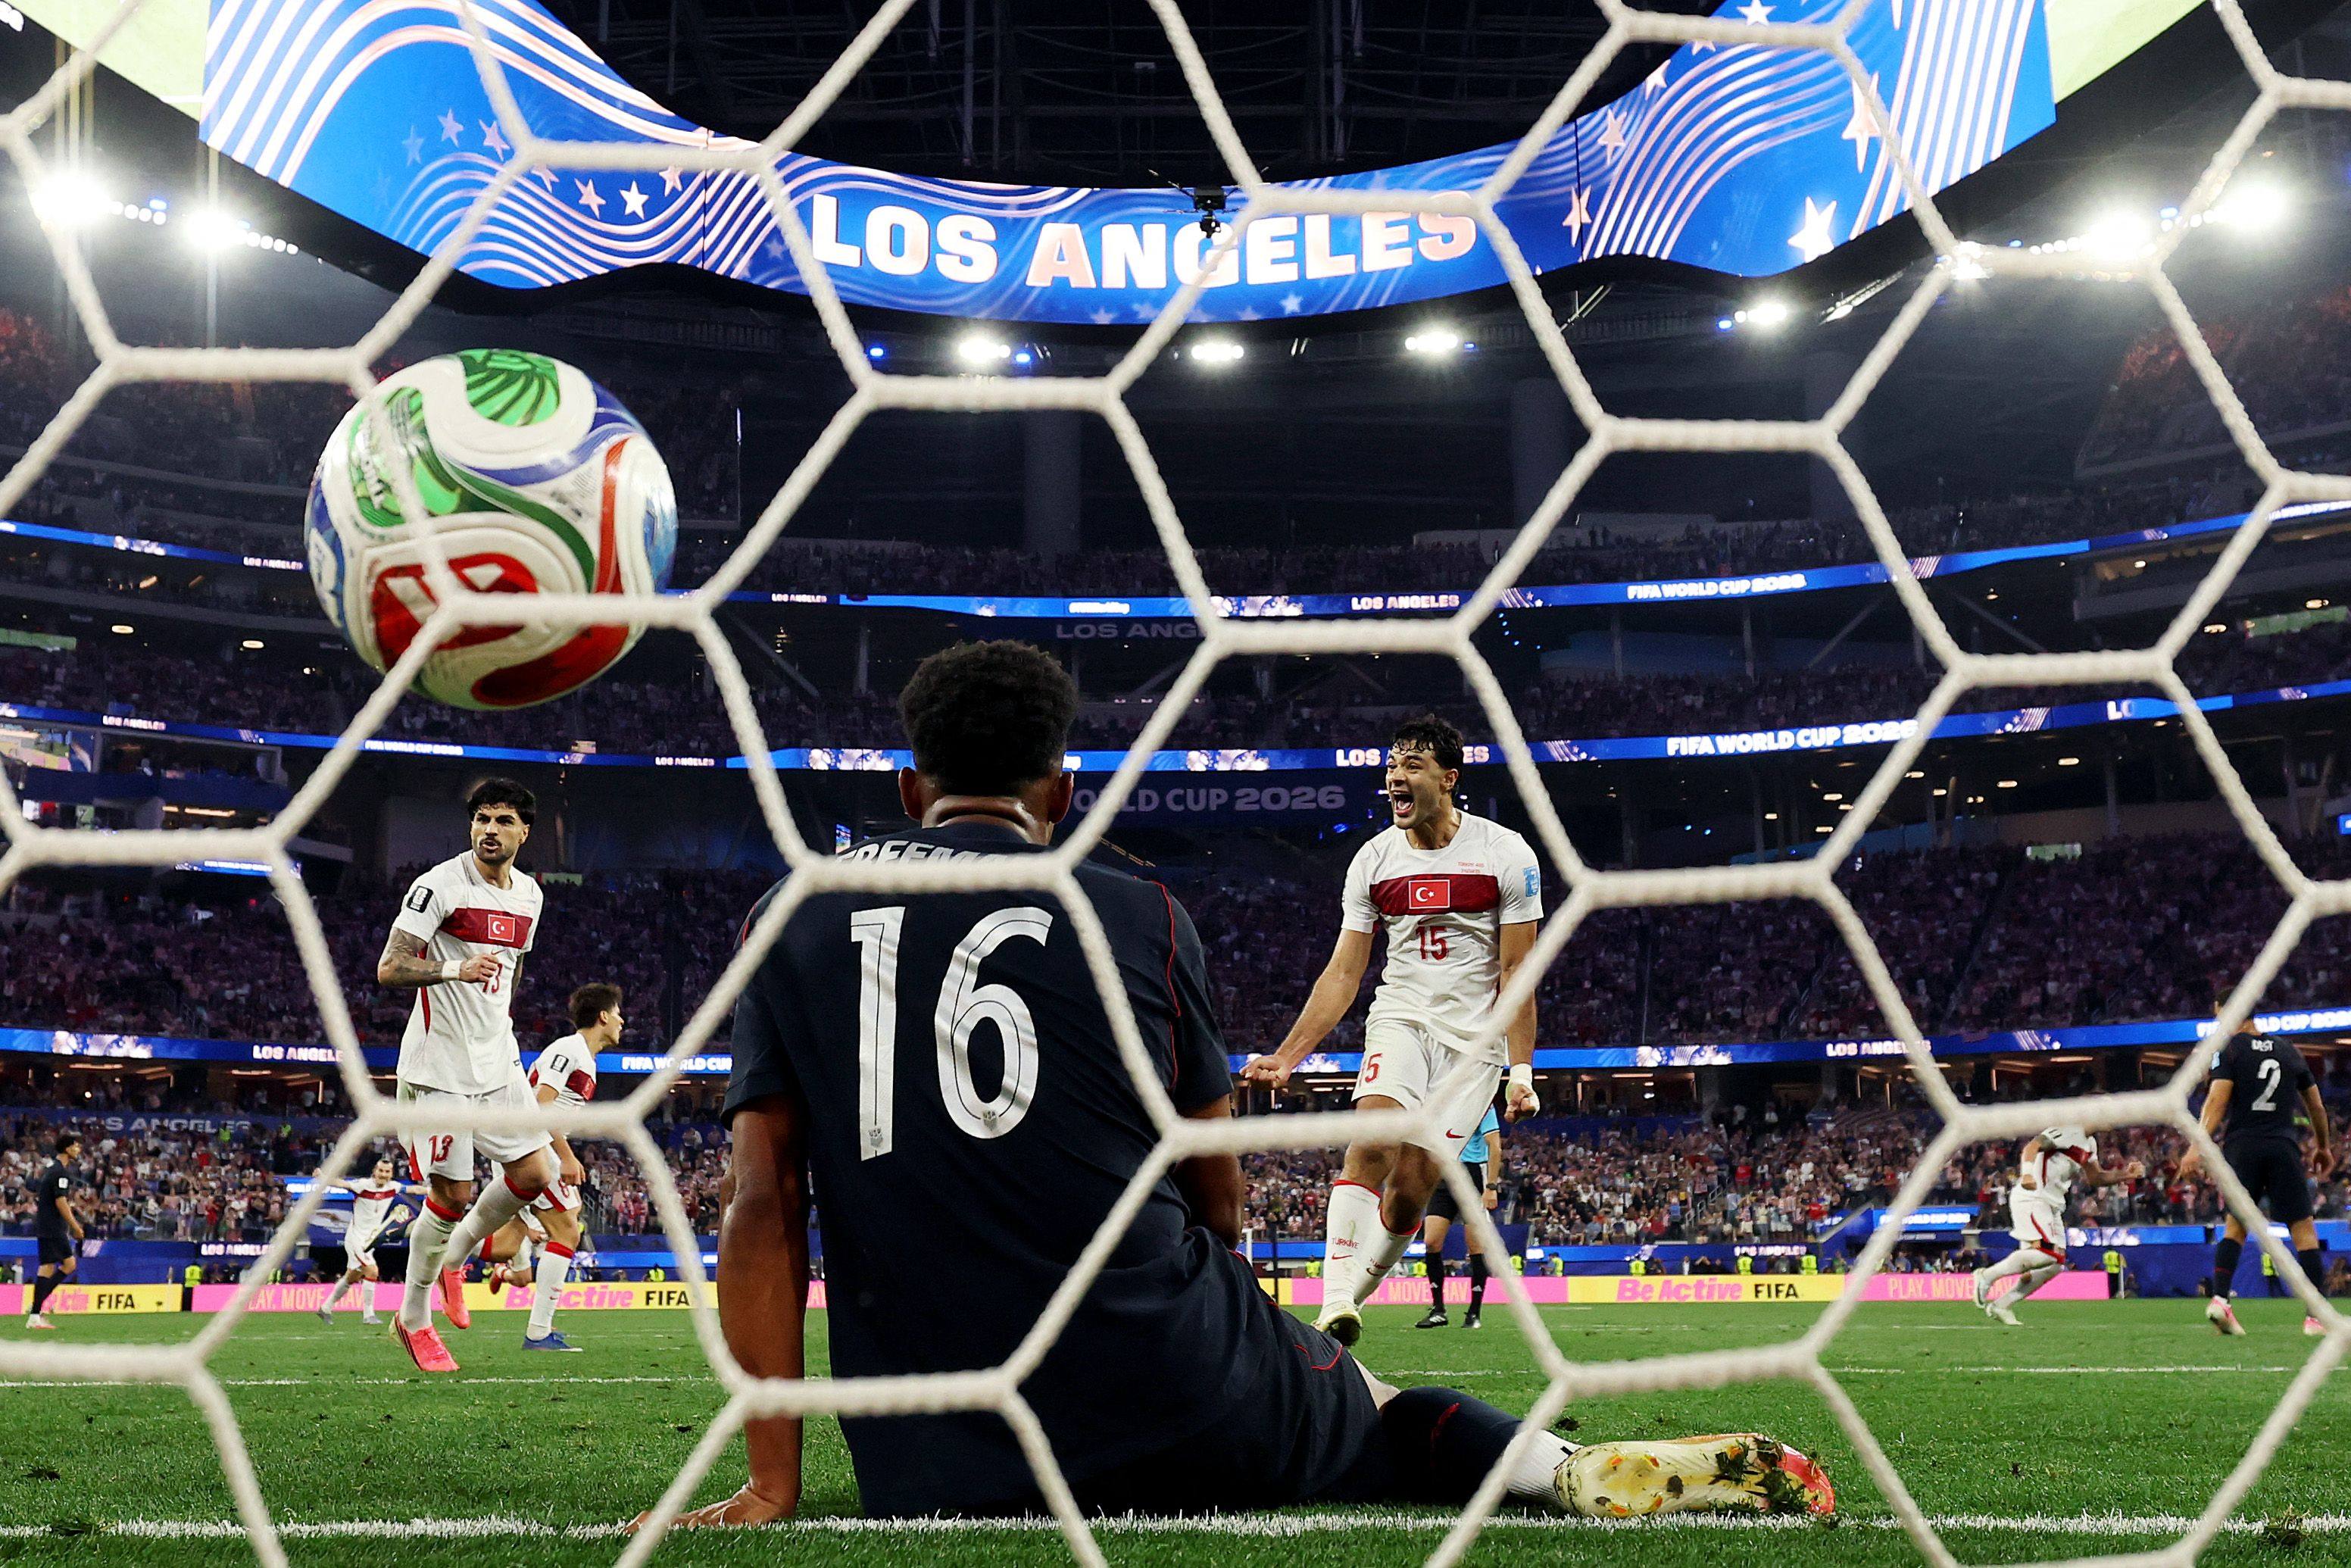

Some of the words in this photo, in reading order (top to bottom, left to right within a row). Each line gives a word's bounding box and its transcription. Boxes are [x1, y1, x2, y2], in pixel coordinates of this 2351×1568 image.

[812, 193, 999, 284] LOS
[1025, 190, 1478, 289] ANGELES
[1627, 584, 1663, 600] FIFA
[1661, 581, 1719, 598] WORLD
[1719, 579, 1752, 595] CUP
[1350, 597, 1384, 611] LOS
[1386, 595, 1460, 609] ANGELES
[1056, 623, 1119, 638] LOS
[1666, 736, 1716, 757] FIFA
[1715, 730, 1795, 754] WORLD
[1796, 726, 1841, 748] CUP
[1841, 719, 1919, 745] 2026
[1335, 748, 1382, 767] LOS
[1165, 788, 1229, 811] CUP
[1234, 786, 1347, 811] 2026
[1415, 926, 1449, 960] 15
[2280, 1014, 2311, 1032] CUP
[850, 906, 1054, 1161] 16
[252, 1045, 285, 1060] LOS
[1825, 1042, 1858, 1057] LOS
[622, 1056, 654, 1070] FIFA
[2251, 1057, 2282, 1112] 2
[428, 1134, 454, 1165] 13
[557, 1285, 634, 1309] ctive
[1616, 1279, 1655, 1302] Be
[1659, 1277, 1743, 1302] Active
[1753, 1283, 1799, 1299] FIFA
[1889, 1278, 1928, 1298] PLAY.
[96, 1294, 136, 1310] FIFA
[645, 1290, 691, 1307] FIFA
